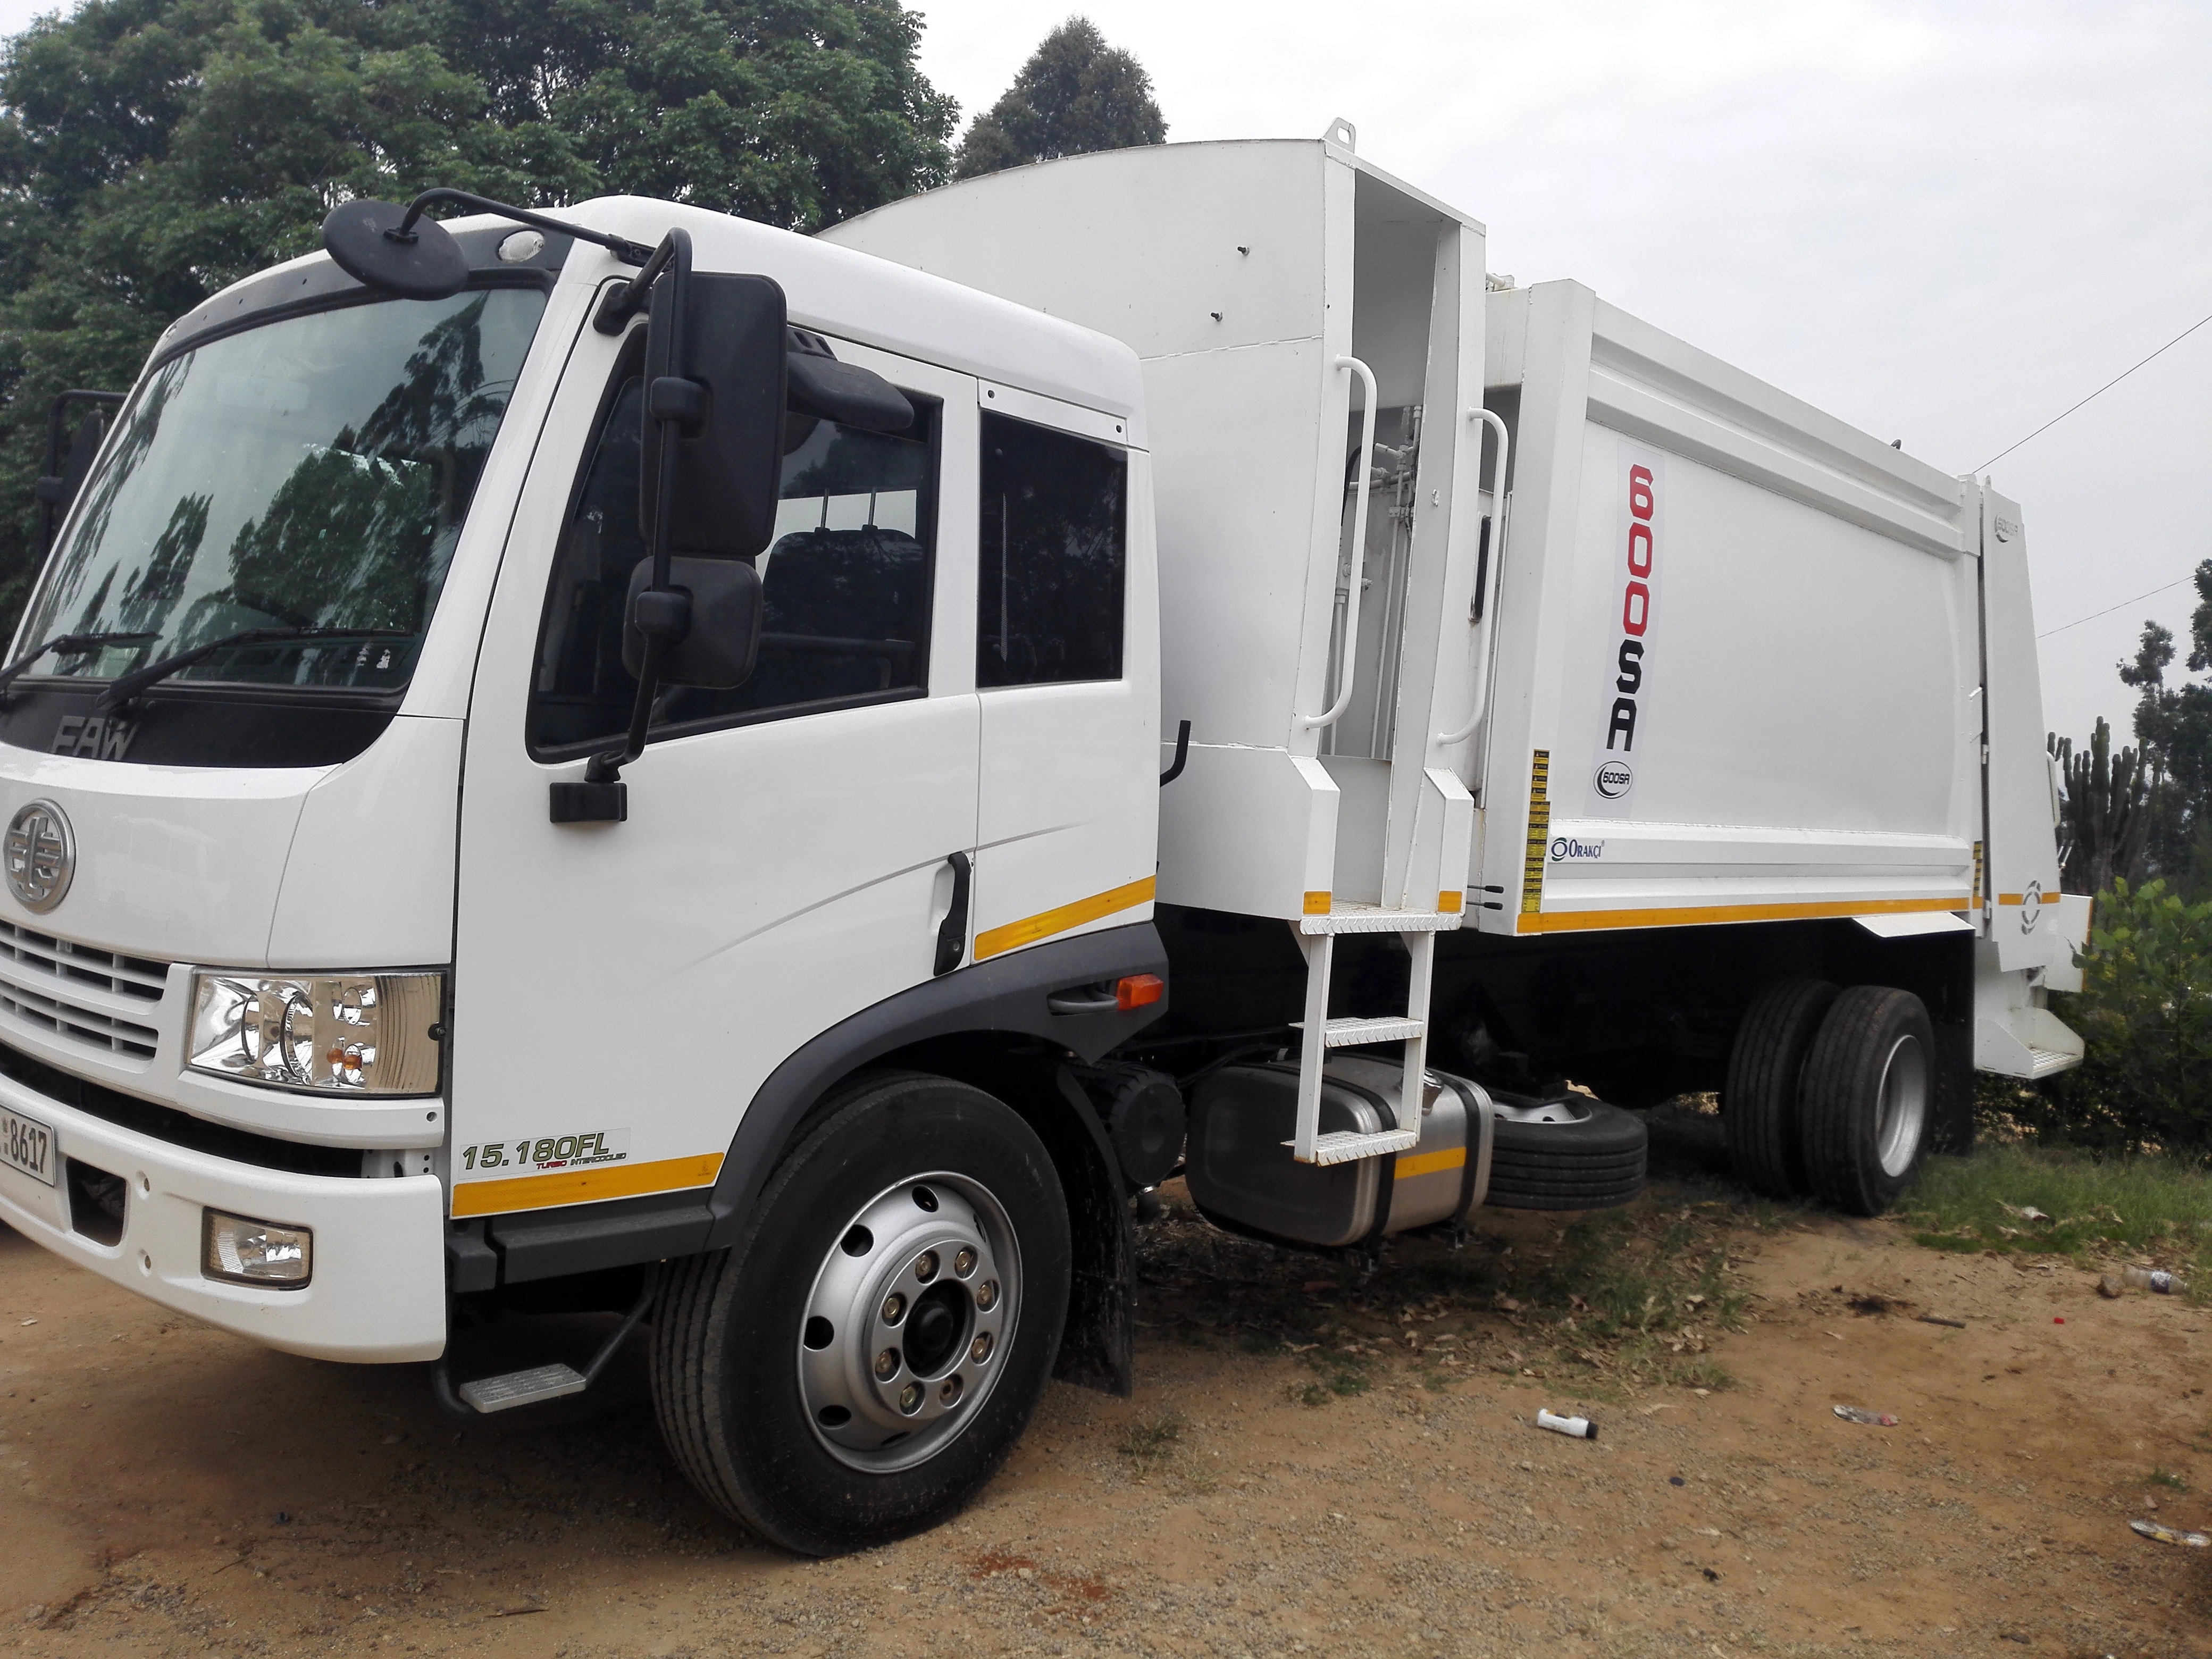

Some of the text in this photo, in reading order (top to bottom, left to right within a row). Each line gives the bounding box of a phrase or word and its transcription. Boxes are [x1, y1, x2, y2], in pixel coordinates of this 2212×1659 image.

[1606, 464, 1654, 752] 600SA
[52, 715, 141, 761] FAW
[1603, 772, 1630, 785] 600SA
[11, 1118, 47, 1174] 8617
[463, 1133, 609, 1170] 15.180FL
[537, 1152, 626, 1170] TURBO INTERCOOLED
